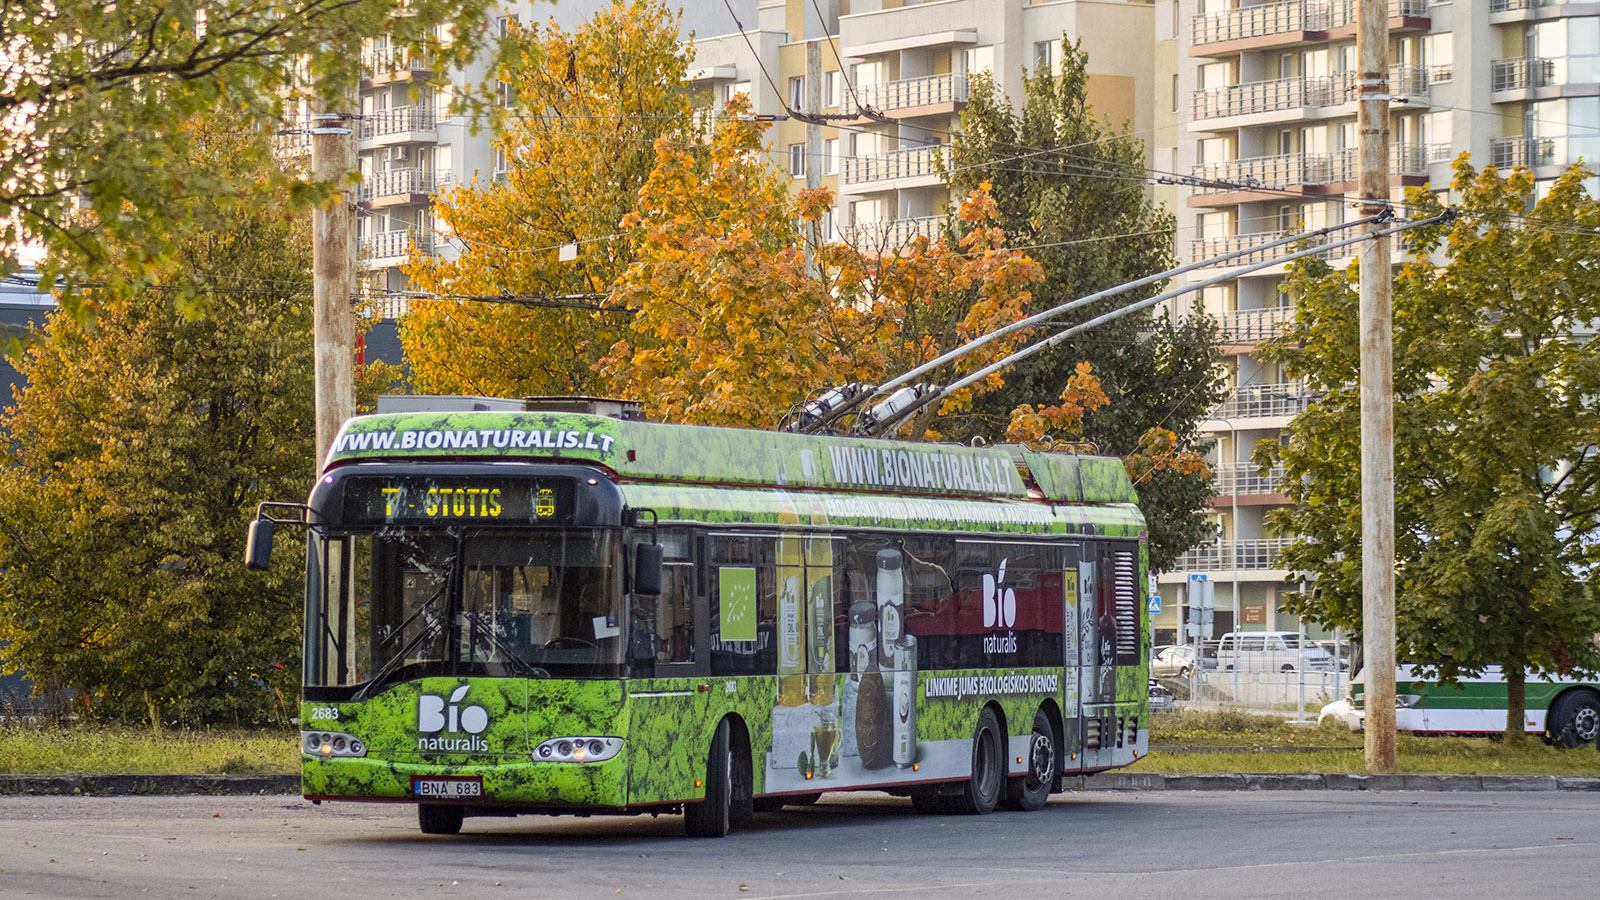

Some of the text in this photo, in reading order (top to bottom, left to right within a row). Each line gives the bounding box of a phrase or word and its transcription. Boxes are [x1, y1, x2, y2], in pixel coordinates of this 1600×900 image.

[829, 446, 1012, 493] WWW.BIONATURALIS.LT
[426, 488, 502, 517] STOTIS
[983, 631, 1017, 654] naturalis
[925, 677, 958, 697] LINKIME
[957, 676, 978, 701] JUMS
[979, 671, 1029, 696] EKOLOGIŠKOS
[1029, 674, 1058, 693] DIENOS!
[311, 707, 339, 720] 2683
[418, 735, 489, 752] naturalis
[421, 782, 479, 795] BNA 683
